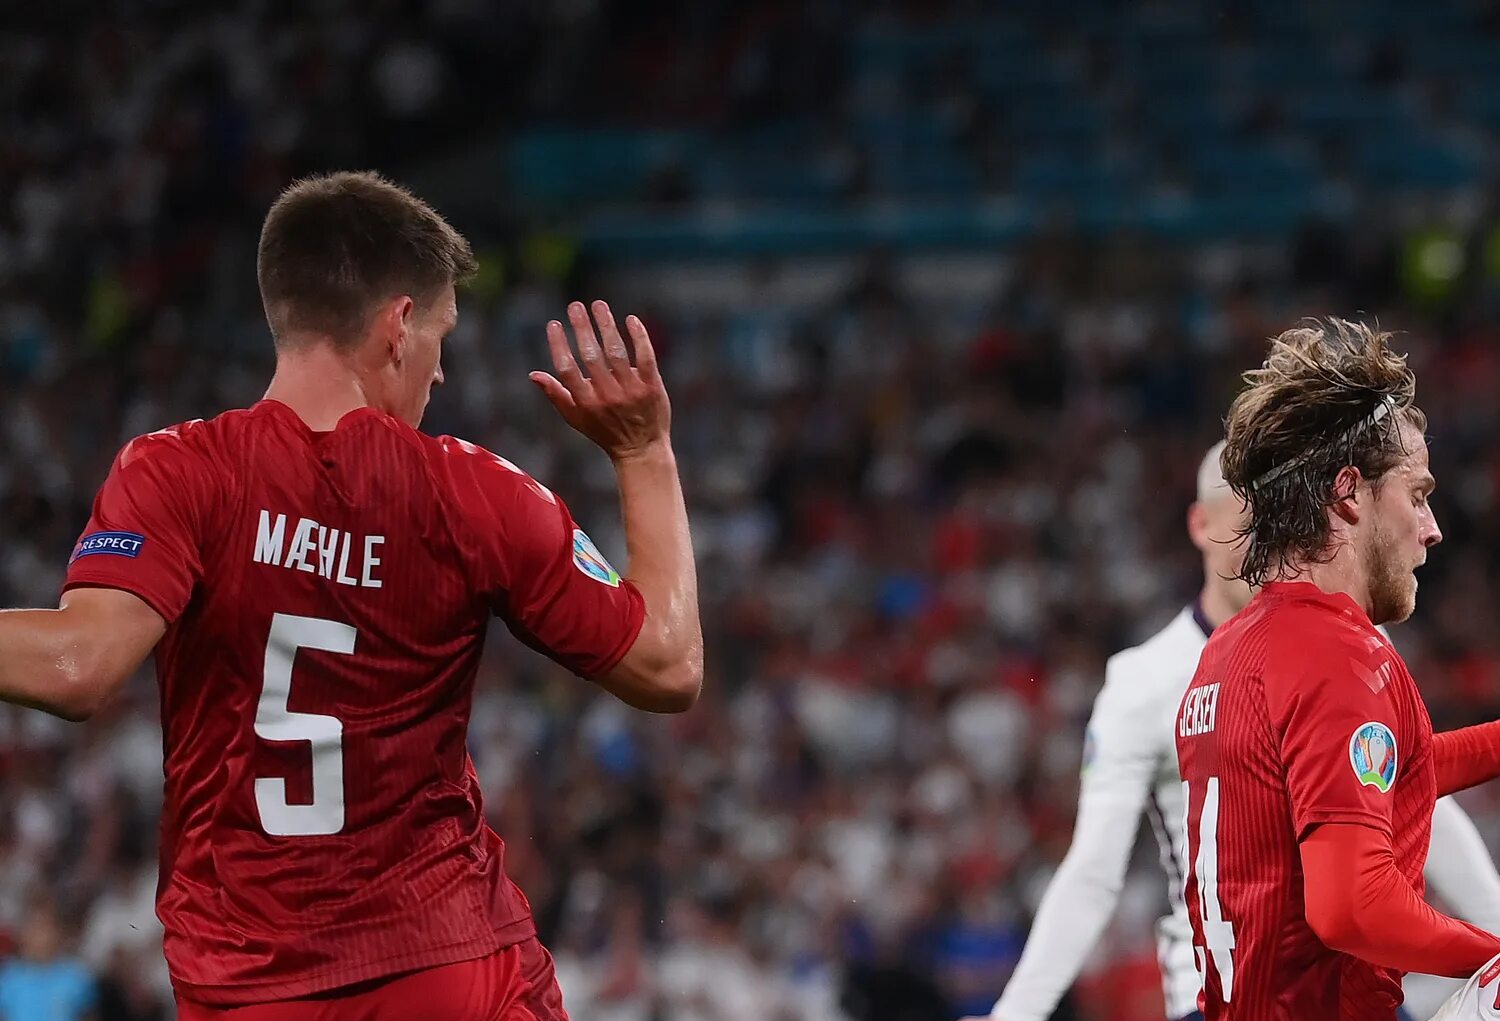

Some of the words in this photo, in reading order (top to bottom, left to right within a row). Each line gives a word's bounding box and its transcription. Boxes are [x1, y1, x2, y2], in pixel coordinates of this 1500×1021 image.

[80, 537, 142, 551] RESPECT
[253, 509, 385, 588] MÆHLE
[253, 612, 357, 836] 5
[1180, 682, 1220, 737] JENSEN
